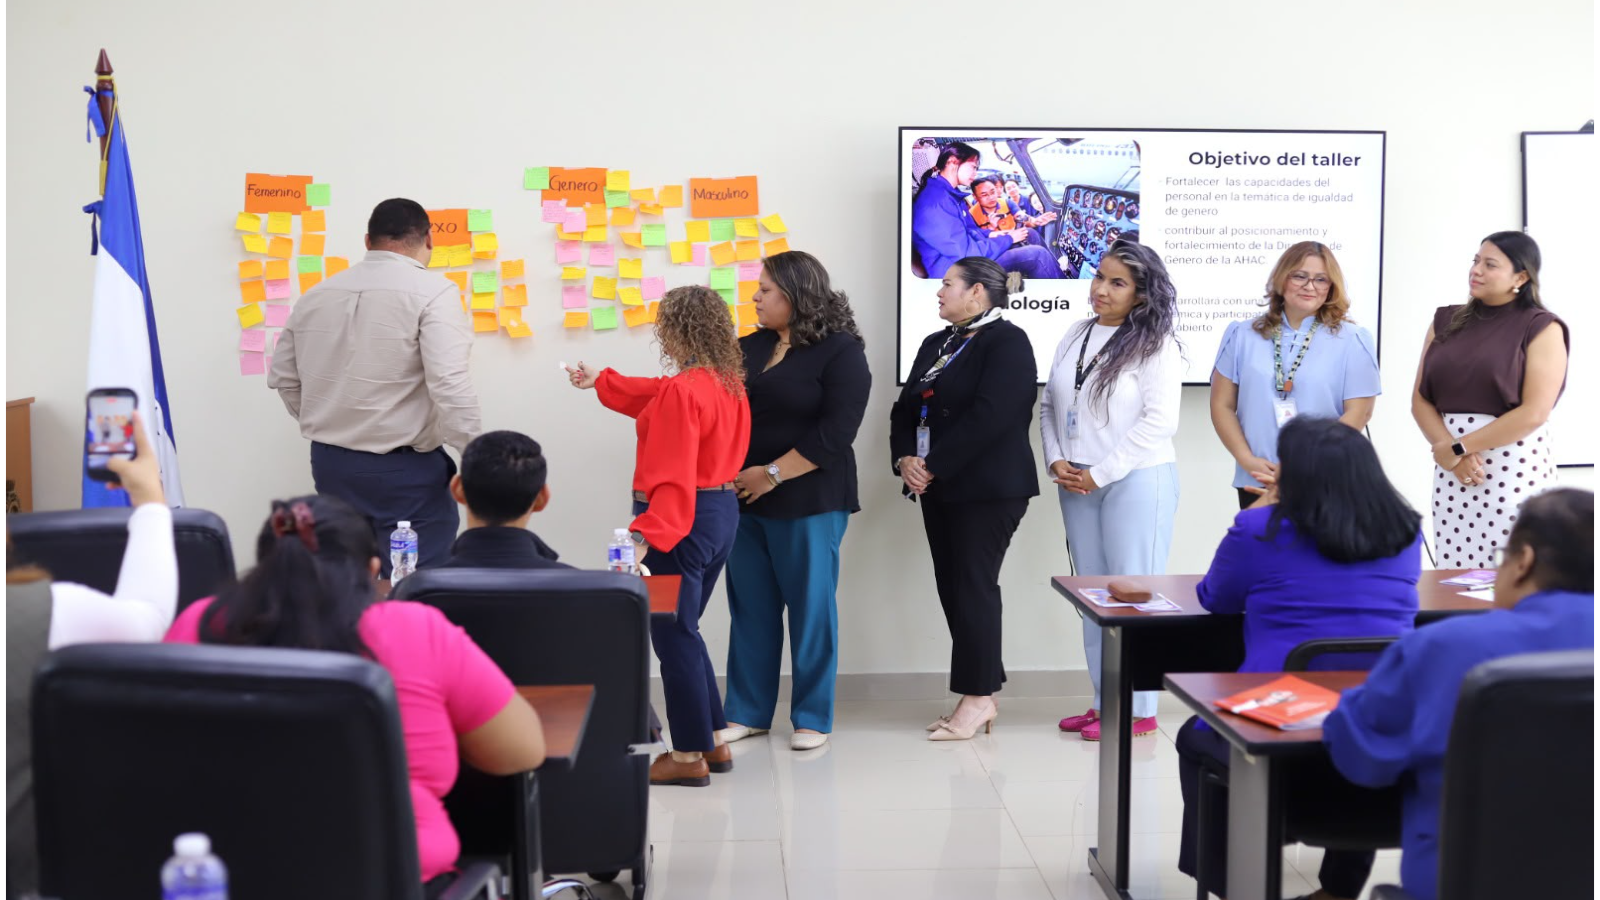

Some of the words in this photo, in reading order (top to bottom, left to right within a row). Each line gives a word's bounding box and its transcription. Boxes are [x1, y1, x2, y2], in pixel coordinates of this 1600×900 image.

[1188, 151, 1271, 168] Objetivo
[1276, 152, 1306, 166] del
[1311, 153, 1361, 166] taller
[549, 174, 598, 192] Genero
[1165, 177, 1220, 187] Fortalecer
[1225, 177, 1241, 187] las
[1243, 178, 1312, 189] capacidades
[1314, 178, 1330, 187] del
[247, 183, 302, 199] Femenino
[693, 187, 749, 201] Masculino
[1165, 192, 1212, 203] personal
[1214, 193, 1228, 202] en
[1230, 192, 1240, 201] la
[1292, 193, 1305, 203] de
[1308, 192, 1354, 204] igualdad
[1165, 206, 1178, 216] de
[1164, 226, 1215, 236] contribuir
[1219, 226, 1228, 236] al
[1231, 227, 1319, 237] posicionamiento
[1322, 228, 1328, 238] y
[1164, 241, 1246, 251] fortalecimiento
[1248, 241, 1261, 251] de
[1264, 241, 1273, 251] la
[1329, 241, 1342, 251] de
[1205, 255, 1219, 265] de
[1222, 255, 1231, 265] la
[1222, 298, 1242, 306] con
[1212, 310, 1262, 320] participat
